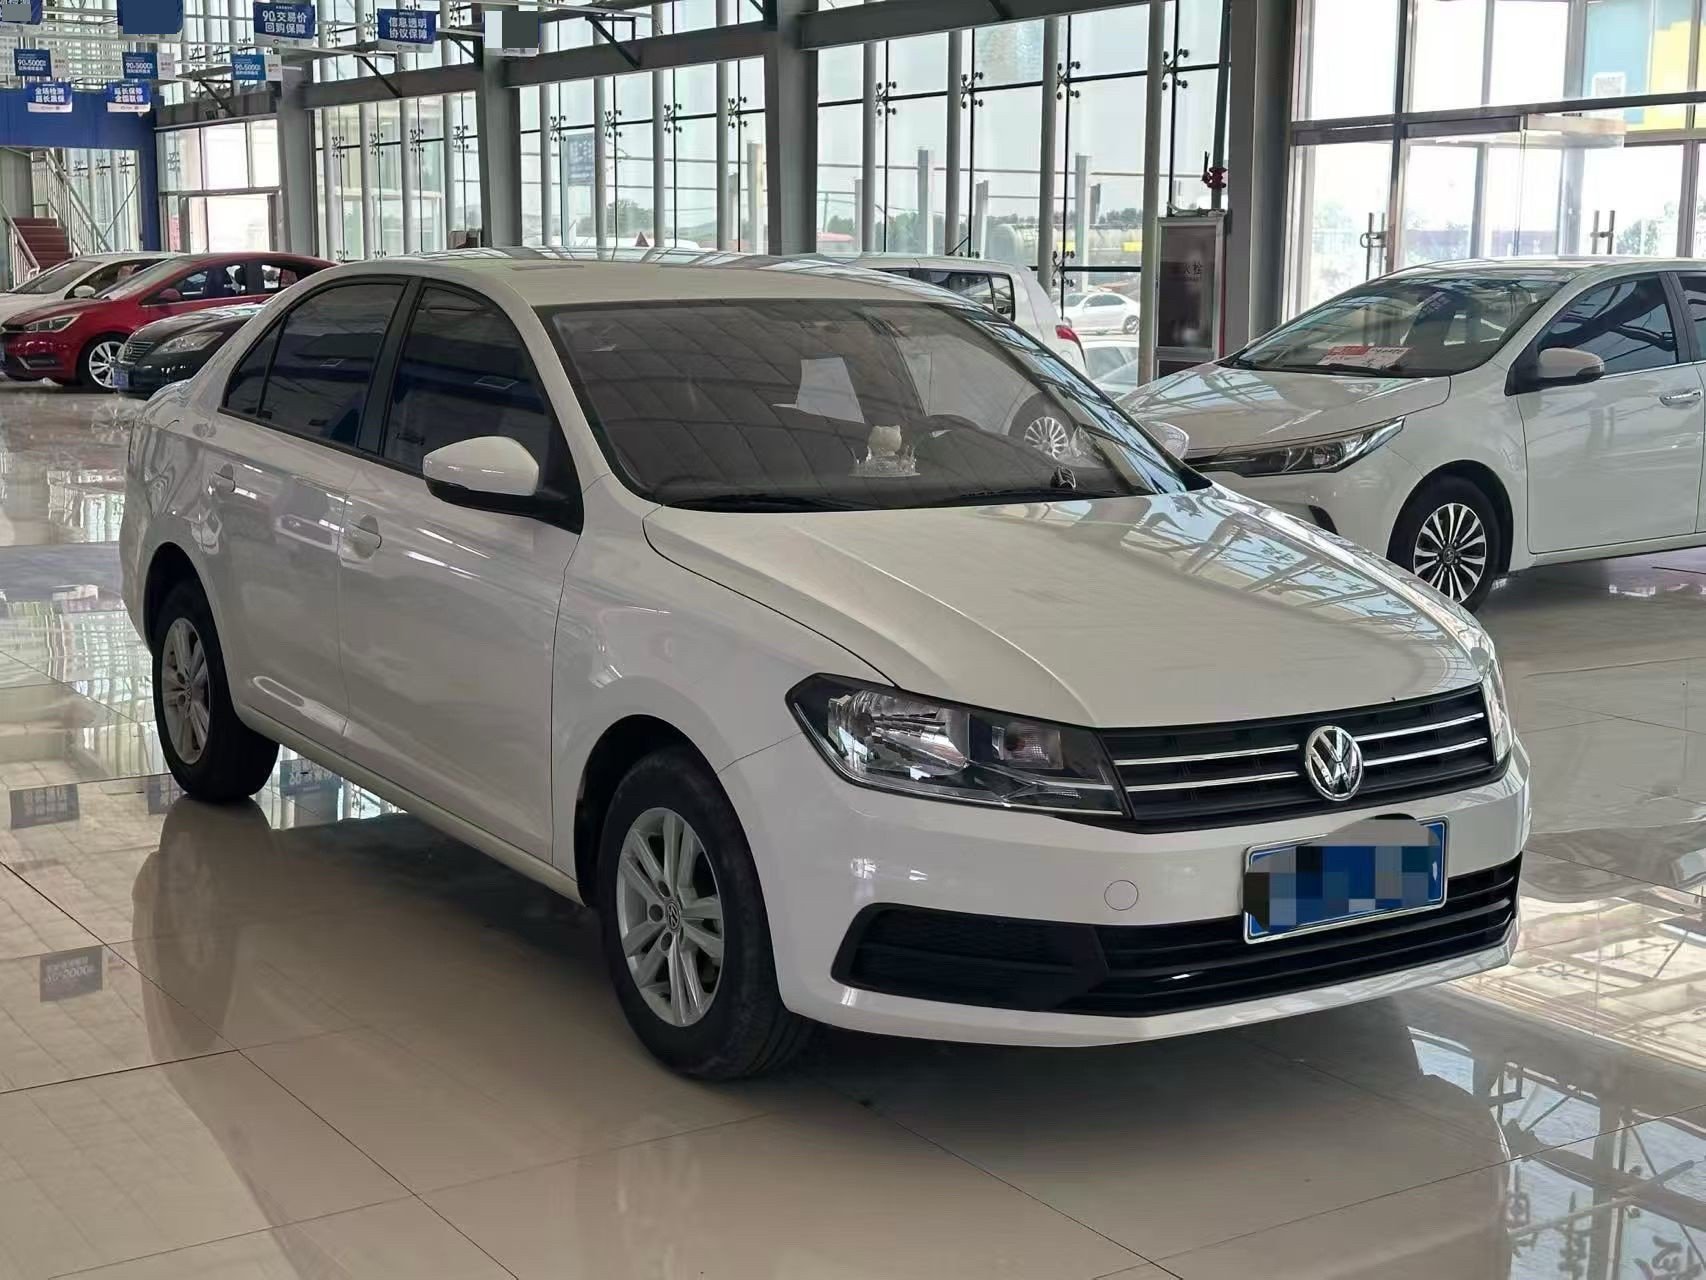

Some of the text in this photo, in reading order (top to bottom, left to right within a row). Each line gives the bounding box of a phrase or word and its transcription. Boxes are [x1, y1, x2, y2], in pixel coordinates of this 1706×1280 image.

[265, 22, 306, 34] 回购保障
[389, 16, 427, 29] 信息透明
[389, 28, 428, 39] 协议保障
